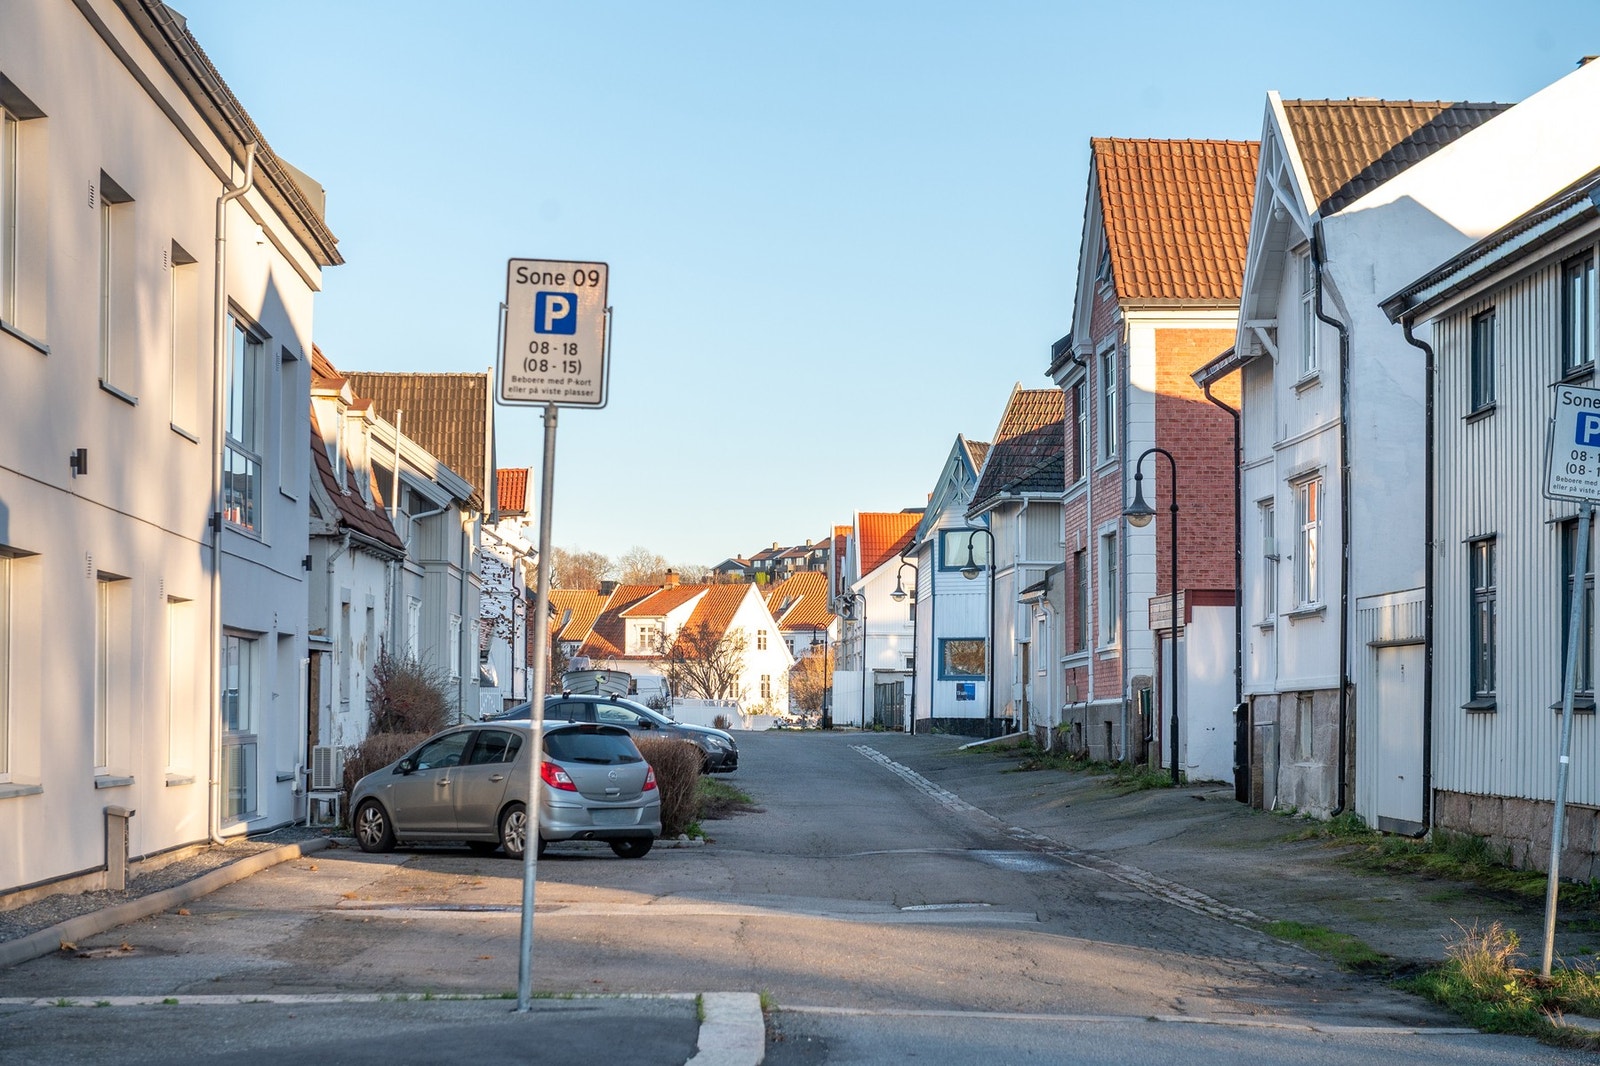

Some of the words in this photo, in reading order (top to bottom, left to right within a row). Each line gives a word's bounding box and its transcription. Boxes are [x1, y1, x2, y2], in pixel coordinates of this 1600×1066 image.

[516, 267, 565, 286] Sone
[573, 269, 600, 287] 09
[544, 295, 570, 331] P
[529, 341, 549, 354] 08
[563, 343, 578, 356] 18
[523, 357, 548, 373] (08
[562, 360, 582, 375] 15)
[512, 376, 544, 385] Beboere
[567, 378, 591, 386] P-kort
[529, 386, 538, 395] på
[564, 389, 594, 397] plasser
[1563, 391, 1600, 409] Sone
[1583, 415, 1600, 443] P
[1571, 450, 1587, 461] 08
[1566, 462, 1585, 475] (08
[1556, 476, 1582, 484] Beboere
